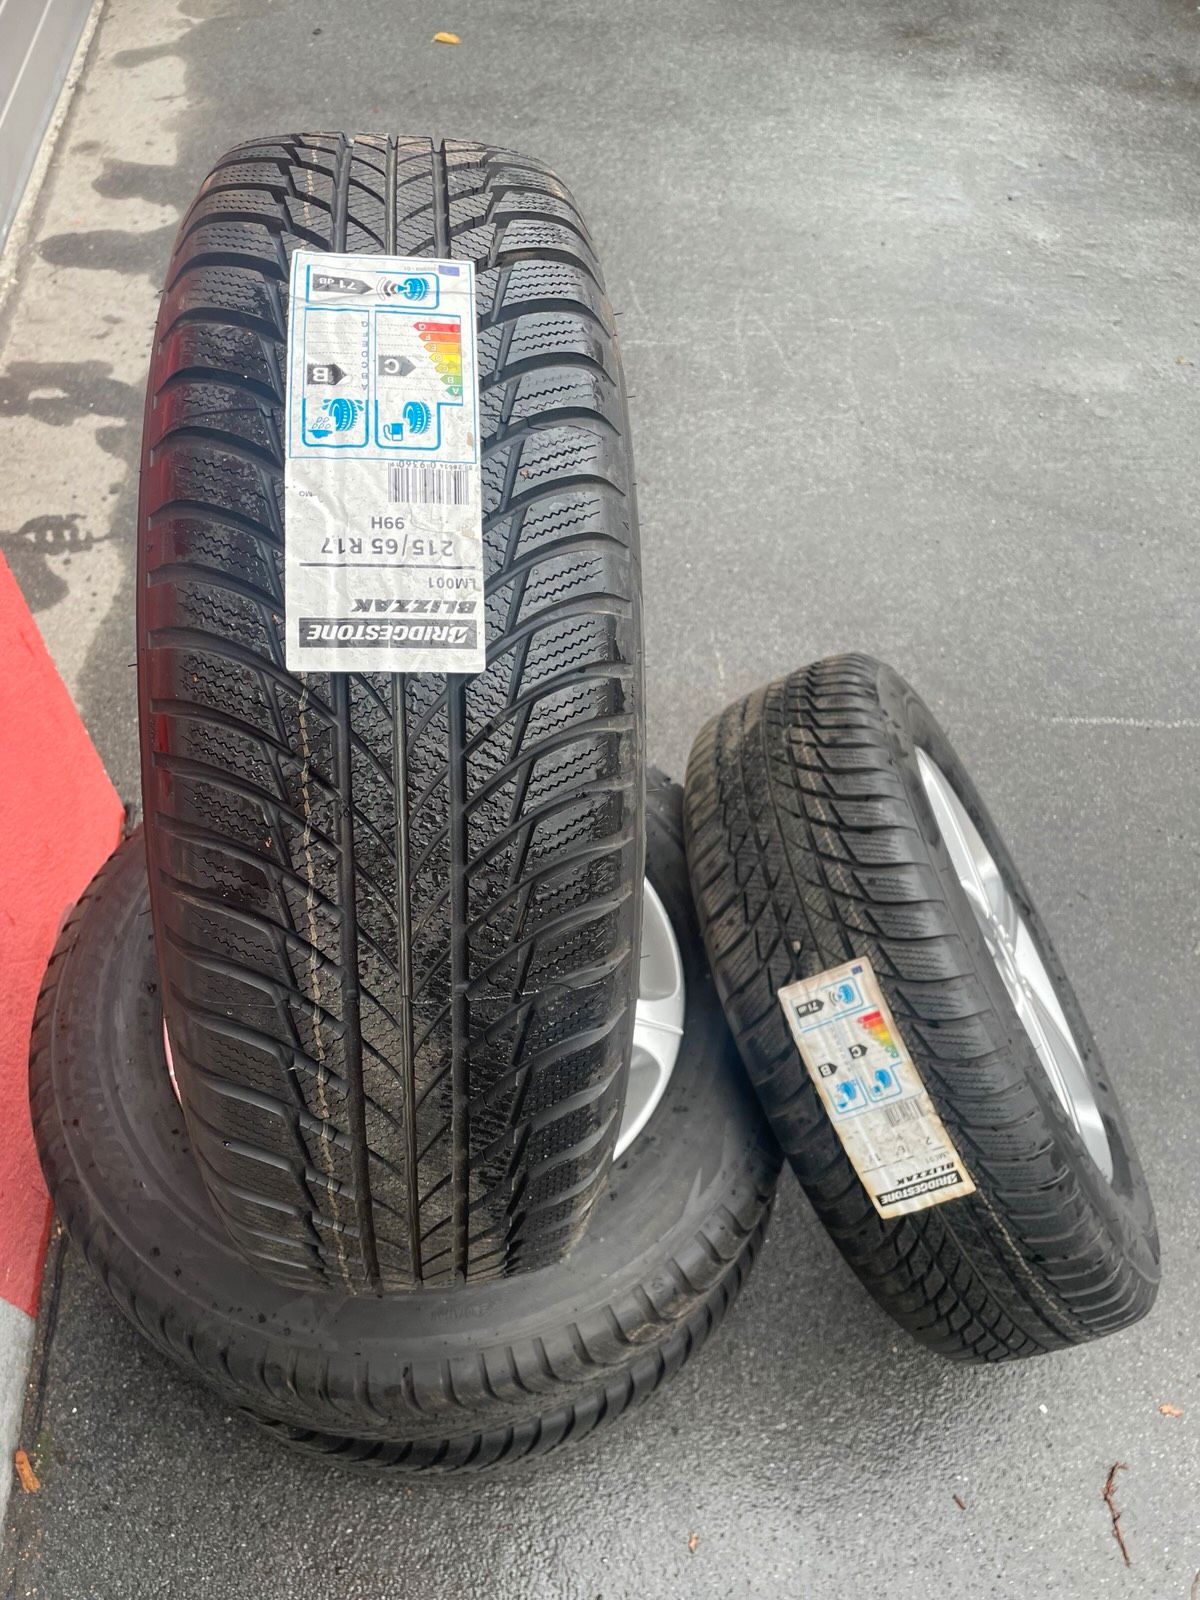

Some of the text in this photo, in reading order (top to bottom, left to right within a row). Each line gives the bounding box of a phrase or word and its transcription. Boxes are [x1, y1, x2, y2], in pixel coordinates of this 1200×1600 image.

[319, 277, 357, 290] 71 dB
[384, 359, 400, 373] C
[313, 367, 329, 381] B
[451, 387, 459, 395] A
[371, 516, 405, 530] 99H
[320, 534, 454, 557] 215/65 R17
[428, 577, 477, 590] LM001
[350, 598, 477, 614] BLIZZAK
[306, 624, 470, 644] BRIDGESTONE
[808, 1000, 819, 1013] 71
[851, 1046, 862, 1057] C
[820, 1066, 831, 1076] B
[896, 1162, 955, 1186] BLIZZAK
[880, 1173, 959, 1205] BRIDGESTONE
